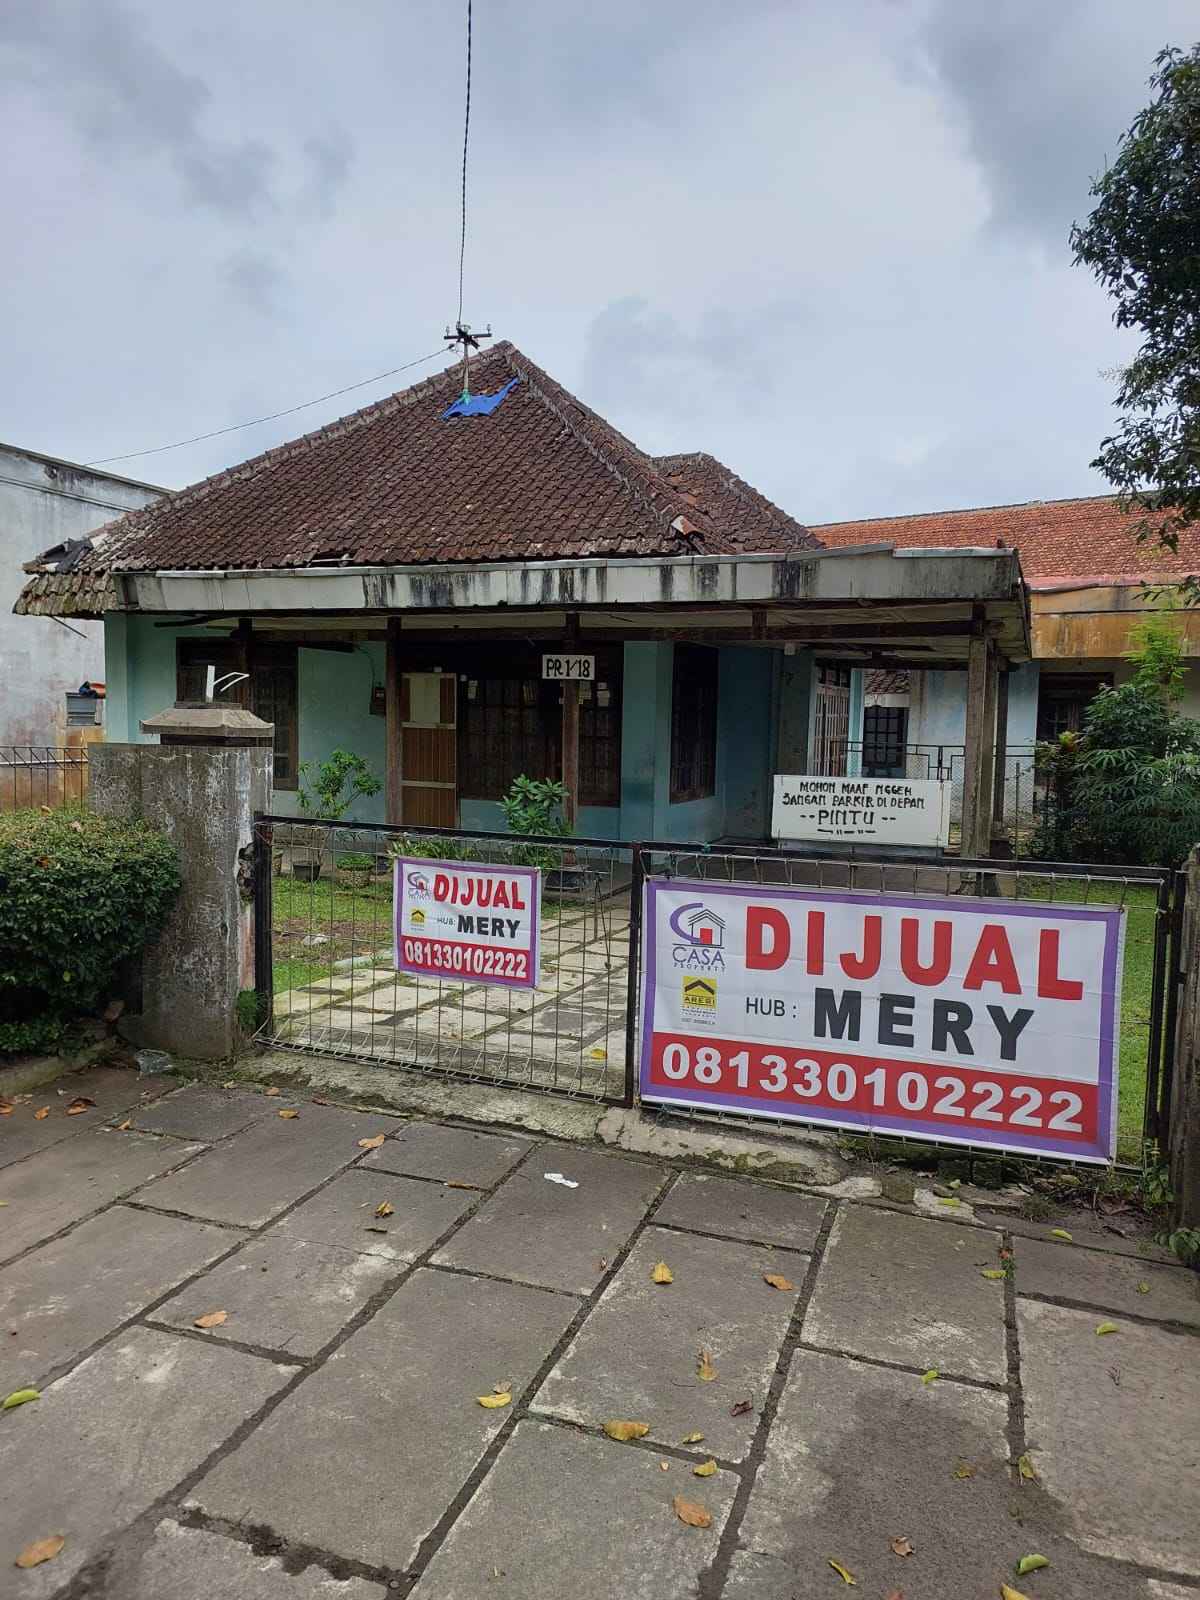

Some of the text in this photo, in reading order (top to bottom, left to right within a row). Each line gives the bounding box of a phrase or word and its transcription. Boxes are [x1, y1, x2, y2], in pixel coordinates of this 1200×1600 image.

[782, 793, 826, 806] JANGAN
[832, 795, 874, 808] PARKIR
[890, 797, 925, 809] DEPAN
[800, 782, 836, 794] MOHON
[841, 783, 869, 795] MAAF
[433, 874, 525, 910] DIJUAL
[457, 915, 521, 939] MERY
[404, 940, 527, 978] 081330102222
[672, 946, 726, 967] CASA
[745, 905, 1084, 1001] DIJUAL
[813, 987, 1035, 1061] MERY
[662, 1043, 1084, 1133] 081330102222
